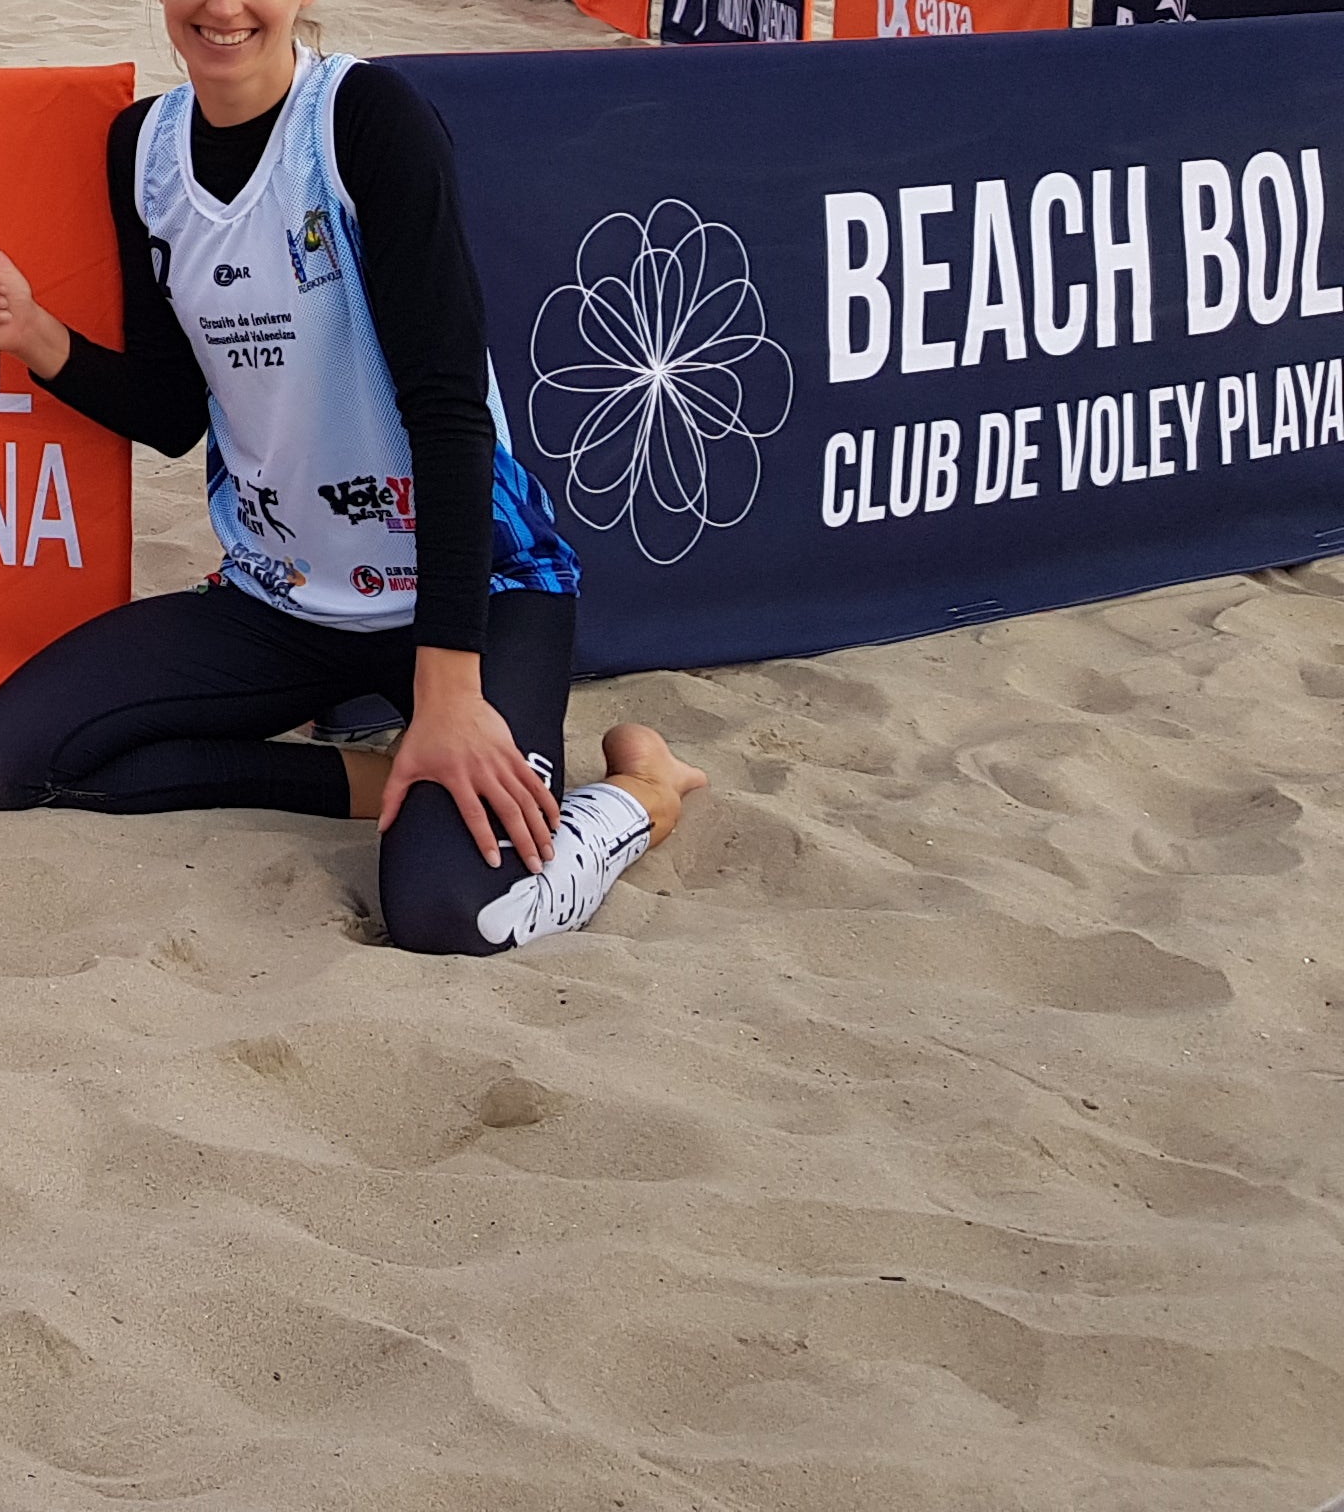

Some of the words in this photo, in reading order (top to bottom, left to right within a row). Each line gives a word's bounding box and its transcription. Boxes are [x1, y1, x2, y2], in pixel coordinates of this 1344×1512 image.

[825, 165, 1154, 385] BEACH
[1181, 148, 1344, 337] BOL
[199, 316, 236, 330] Circuito
[237, 313, 250, 327] de
[250, 312, 292, 327] Invierno
[227, 346, 285, 369] 21/22
[822, 418, 963, 529] CLUB
[973, 407, 1043, 506] DE
[1056, 381, 1207, 492] VOLEY
[1218, 358, 1344, 466] PLAYA
